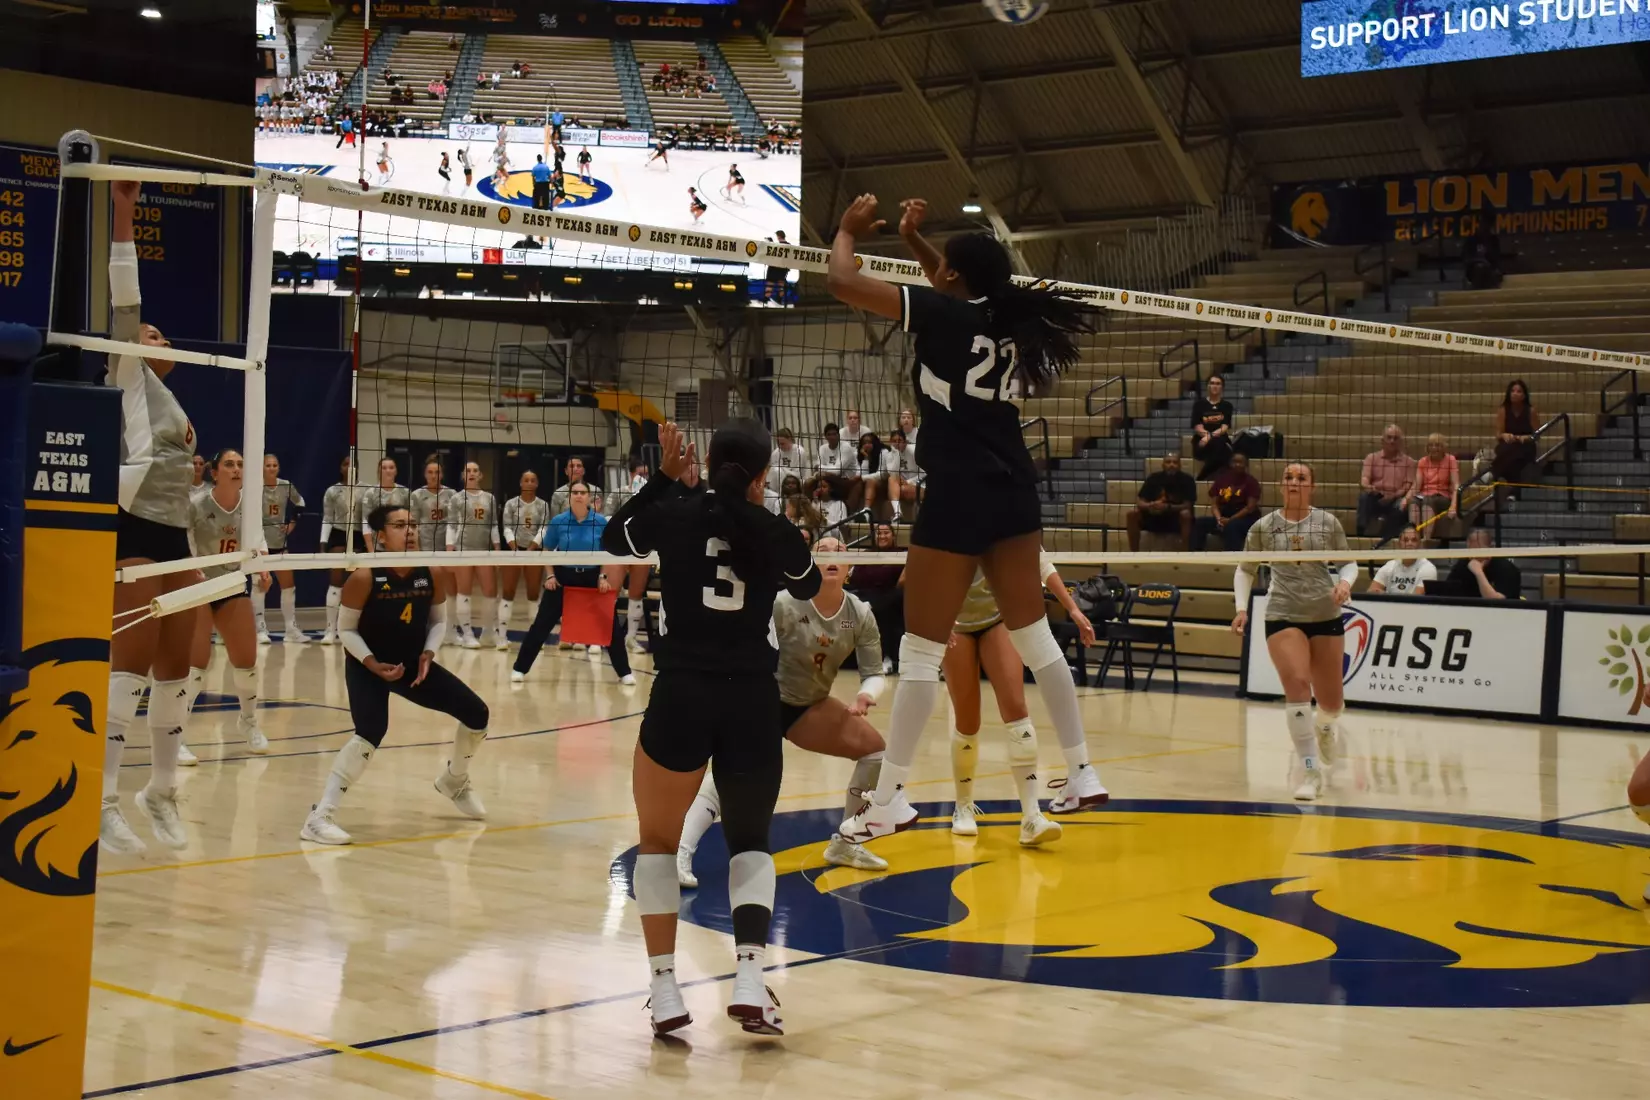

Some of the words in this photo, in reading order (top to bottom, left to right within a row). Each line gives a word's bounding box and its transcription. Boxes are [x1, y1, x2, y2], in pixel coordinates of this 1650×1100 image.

[648, 16, 702, 27] LIONS
[1310, 13, 1435, 50] SUPPORT
[1444, 4, 1510, 35] LION
[1518, 0, 1650, 26] STUDEN
[602, 134, 647, 142] Brookshire's
[24, 164, 60, 178] GOLF
[1384, 172, 1508, 216] LION
[150, 196, 216, 210] TOURNAMENT
[381, 192, 414, 206] EAST
[418, 198, 458, 214] TEXAS
[461, 203, 487, 218] A&M
[134, 206, 162, 222] 019
[134, 224, 160, 240] 021
[522, 212, 552, 227] EAST
[556, 218, 592, 232] TEXAS
[596, 222, 618, 236] A&M
[650, 230, 678, 245] EAST
[680, 235, 713, 250] TEXAS
[715, 239, 736, 252] A&M
[766, 246, 790, 260] EAST
[792, 249, 822, 262] TEXAS
[870, 260, 892, 273] EAST
[894, 264, 922, 277] TEXAS
[1100, 291, 1115, 300] A&M
[1134, 295, 1152, 305] EAST
[1154, 298, 1174, 309] TEXAS
[1176, 302, 1190, 312] A&M
[1208, 306, 1224, 316] EAST
[1226, 308, 1246, 318] TEXAS
[1248, 312, 1260, 320] A&M
[1276, 314, 1292, 324] EAST
[1294, 316, 1312, 326] TEXAS
[1313, 318, 1325, 328] A&M
[1341, 322, 1355, 332] EAST
[1356, 324, 1373, 334] TEXAS
[1374, 326, 1386, 335] A&M
[964, 334, 1019, 401] 22
[46, 431, 85, 446] EAST
[40, 452, 88, 467] TEXAS
[33, 470, 91, 494] A&M
[269, 504, 280, 515] 15
[474, 508, 484, 520] 12
[525, 518, 532, 528] 5
[220, 539, 238, 554] 16
[702, 536, 745, 611] 3
[1138, 590, 1172, 598] LIONS
[400, 602, 412, 624] 4
[1370, 624, 1473, 672] ASG
[814, 653, 826, 672] 9
[1370, 671, 1394, 680] ALL
[1404, 673, 1465, 686] SYSTEMS
[1474, 678, 1492, 687] GO
[1369, 682, 1424, 694] HVAC-R
